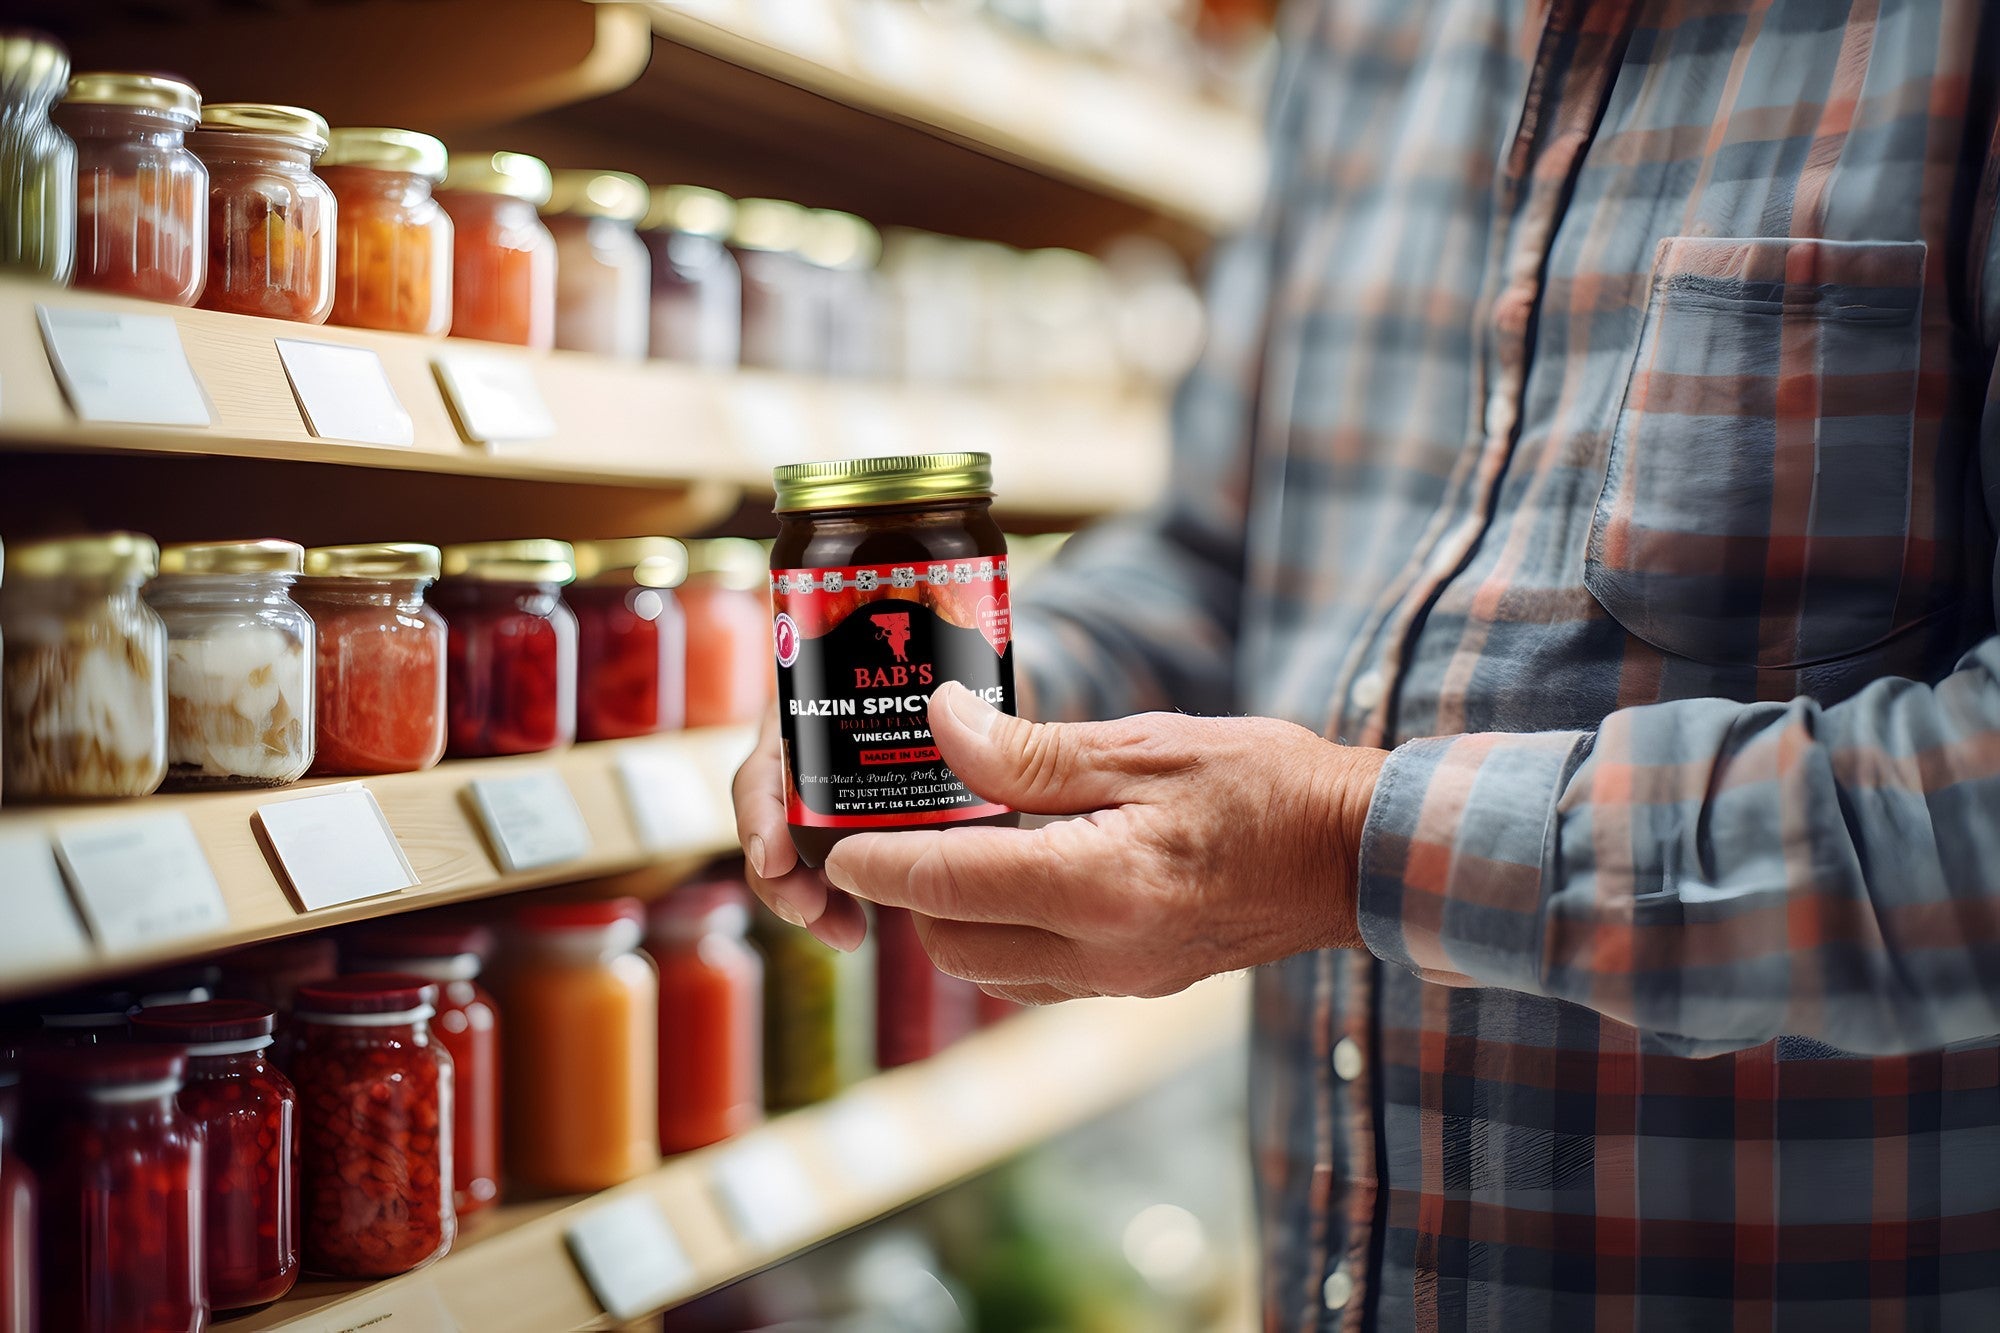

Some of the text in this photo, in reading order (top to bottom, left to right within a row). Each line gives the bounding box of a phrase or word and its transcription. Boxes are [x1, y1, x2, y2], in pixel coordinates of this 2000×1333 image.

[854, 663, 933, 688] BAB'S
[789, 698, 856, 716] BLAZIN
[840, 717, 880, 730] BOLD
[852, 729, 932, 742] VINEGAR BA
[864, 750, 936, 761] MADE IN USA
[799, 773, 818, 786] Great
[866, 771, 907, 785] Poultry,
[911, 768, 938, 781] Pork,
[838, 782, 964, 799] IT'S JUST THAT DELICIUOS!
[852, 802, 866, 810] WT
[874, 801, 888, 809] PT.
[889, 800, 903, 809] (16
[905, 797, 936, 807] FL.OZ.)
[937, 796, 955, 805] (473
[956, 793, 972, 803] ML.)
